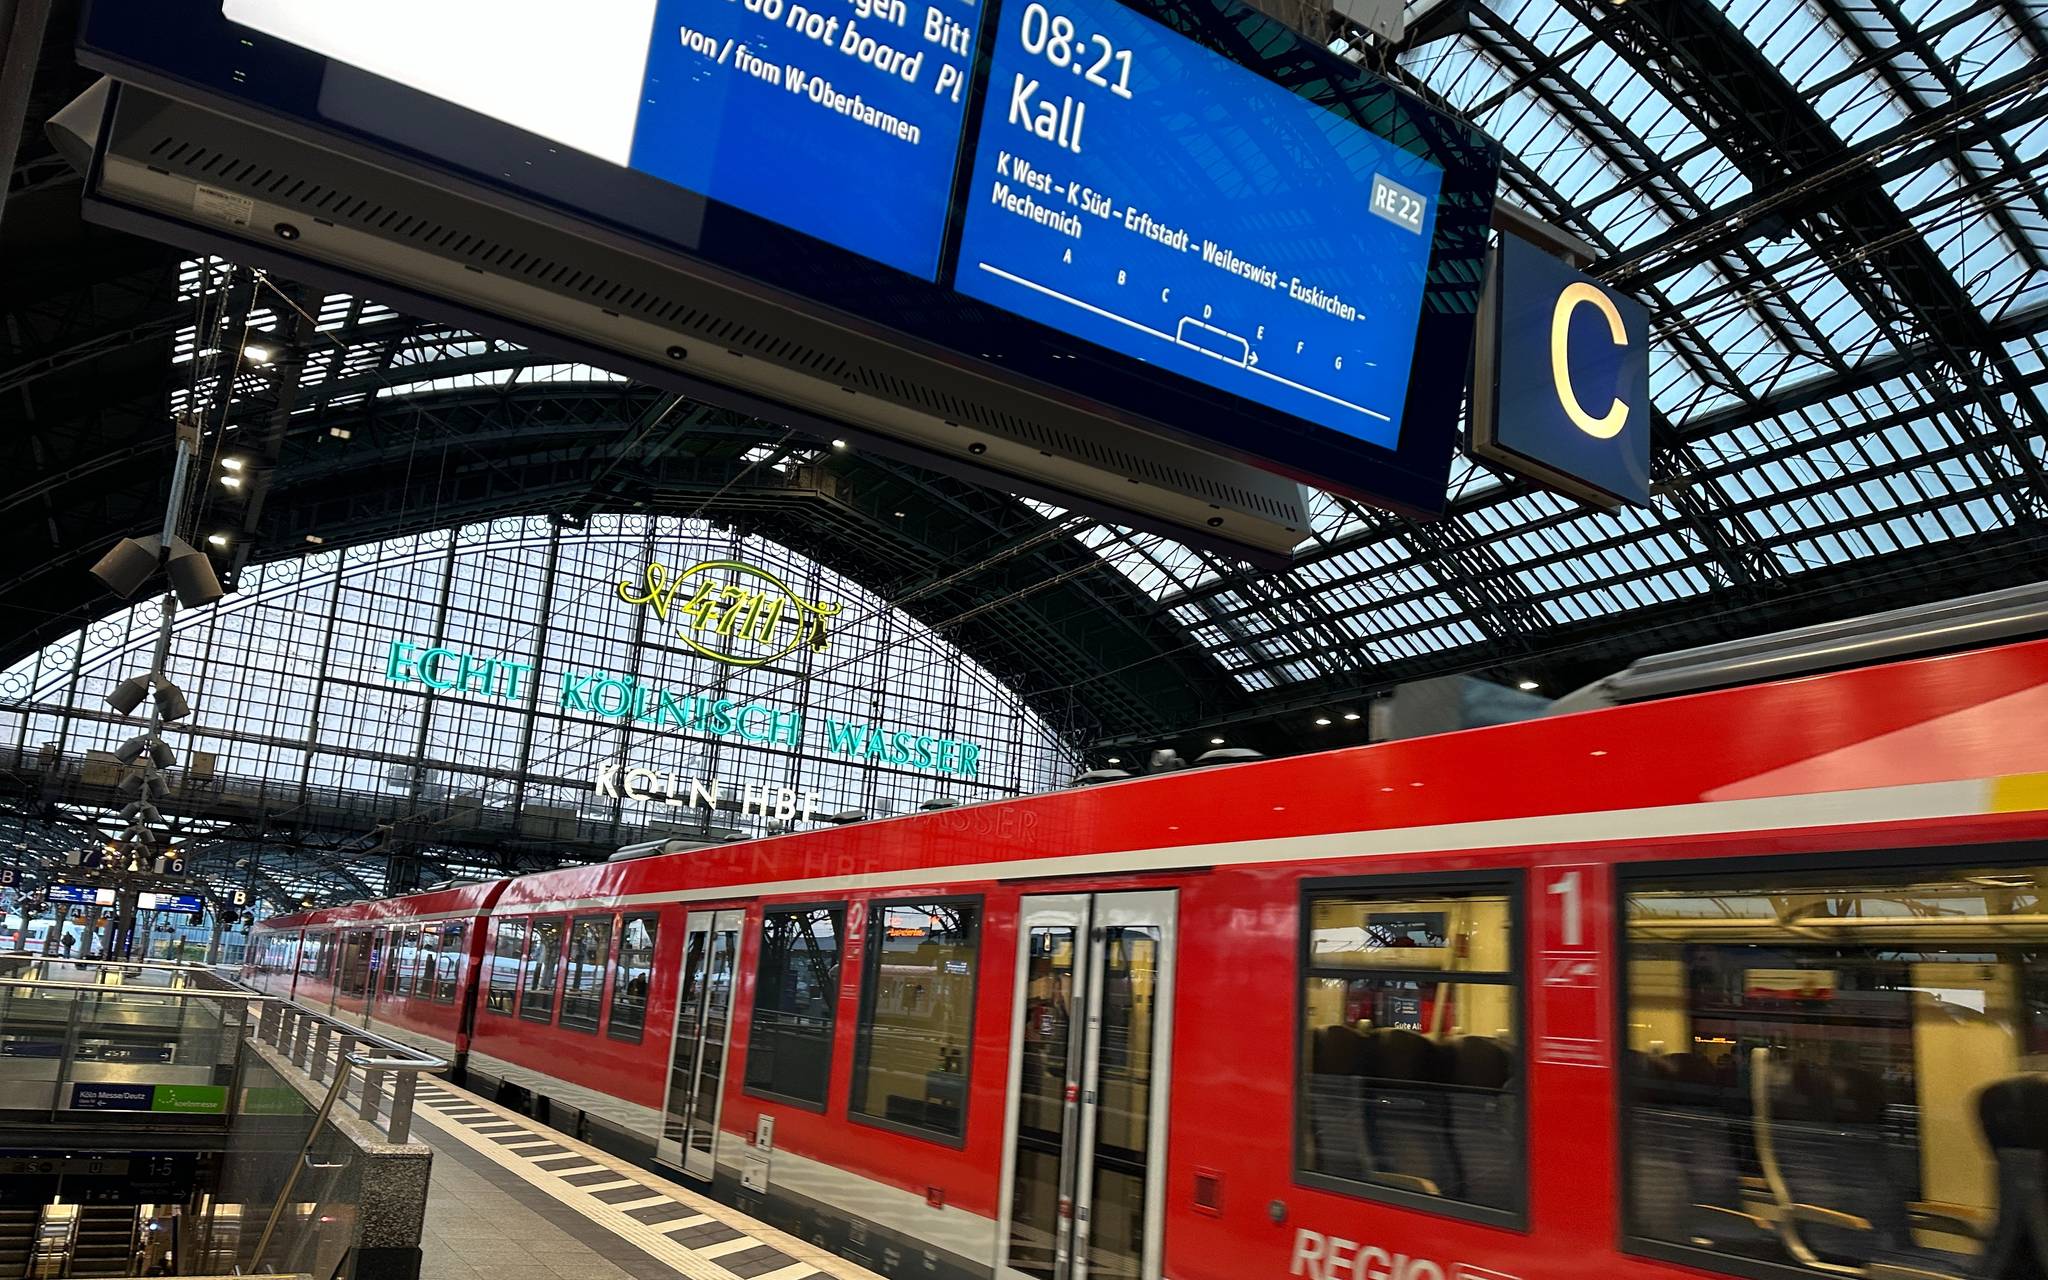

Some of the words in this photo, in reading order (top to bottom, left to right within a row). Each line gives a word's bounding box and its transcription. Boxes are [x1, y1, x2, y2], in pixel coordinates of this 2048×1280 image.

[786, 5, 838, 46] not
[840, 20, 923, 83] board
[934, 63, 964, 103] Pl
[848, 0, 906, 27] gen
[924, 6, 971, 57] Bitt
[1021, 3, 1132, 99] 08:21
[680, 26, 717, 58] von
[734, 44, 781, 85] from
[786, 65, 920, 145] W-Oberbarmen
[1008, 73, 1085, 154] Kall
[992, 182, 1082, 239] Mechernich
[1375, 184, 1397, 213] RE
[1399, 194, 1421, 225] 22
[997, 151, 1011, 176] K
[1013, 157, 1052, 194] West
[1067, 182, 1081, 206] K
[1081, 188, 1112, 219] Süd
[1125, 207, 1189, 253] Erftstadt
[1202, 240, 1278, 289] Weilerswist
[1289, 277, 1356, 322] Euskirchen
[1063, 249, 1072, 264] A
[1117, 270, 1126, 285] B
[1162, 288, 1170, 303] C
[1203, 305, 1212, 319] D
[1257, 326, 1264, 340] E
[1297, 341, 1304, 354] F
[1335, 356, 1342, 370] G
[1551, 282, 1630, 439] C
[682, 579, 786, 643] 4711
[387, 639, 534, 700] ECHT
[560, 670, 799, 747] KÖLNISCH
[827, 719, 980, 777] WASSER
[595, 763, 718, 811] KÖLN
[742, 782, 823, 823] HBF
[2, 870, 14, 883] B
[83, 850, 94, 863] 7
[172, 859, 183, 872] 6
[233, 891, 246, 905] B
[848, 902, 863, 940] 2
[1547, 871, 1583, 946] 1
[149, 1163, 173, 1176] 1-5
